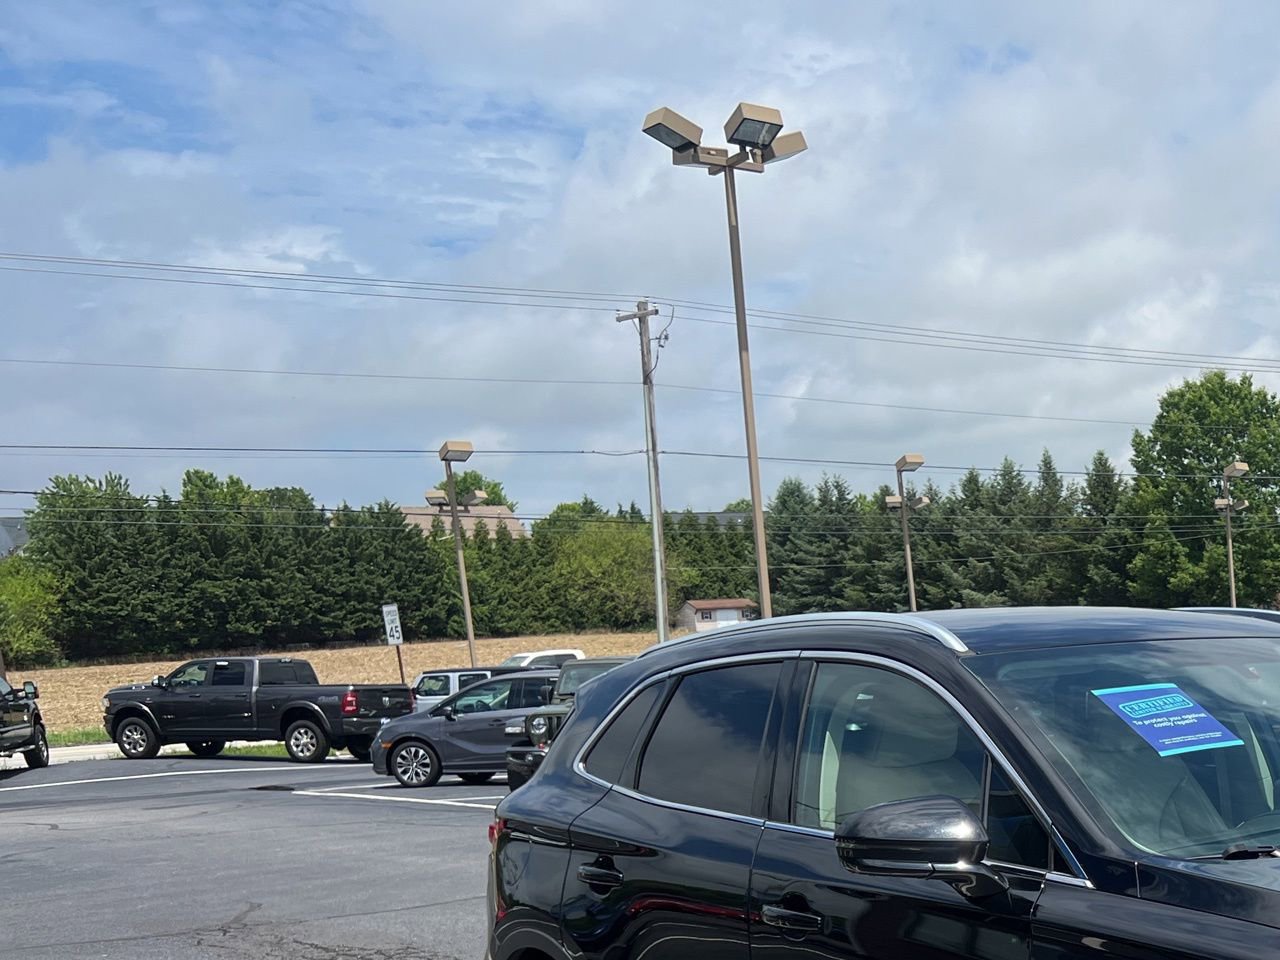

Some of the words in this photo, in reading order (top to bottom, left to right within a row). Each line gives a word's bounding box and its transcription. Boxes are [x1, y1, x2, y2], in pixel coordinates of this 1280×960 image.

[389, 625, 401, 640] 45
[1125, 696, 1183, 713] CERTIFIED
[1143, 717, 1168, 725] protect
[1168, 716, 1182, 724] you
